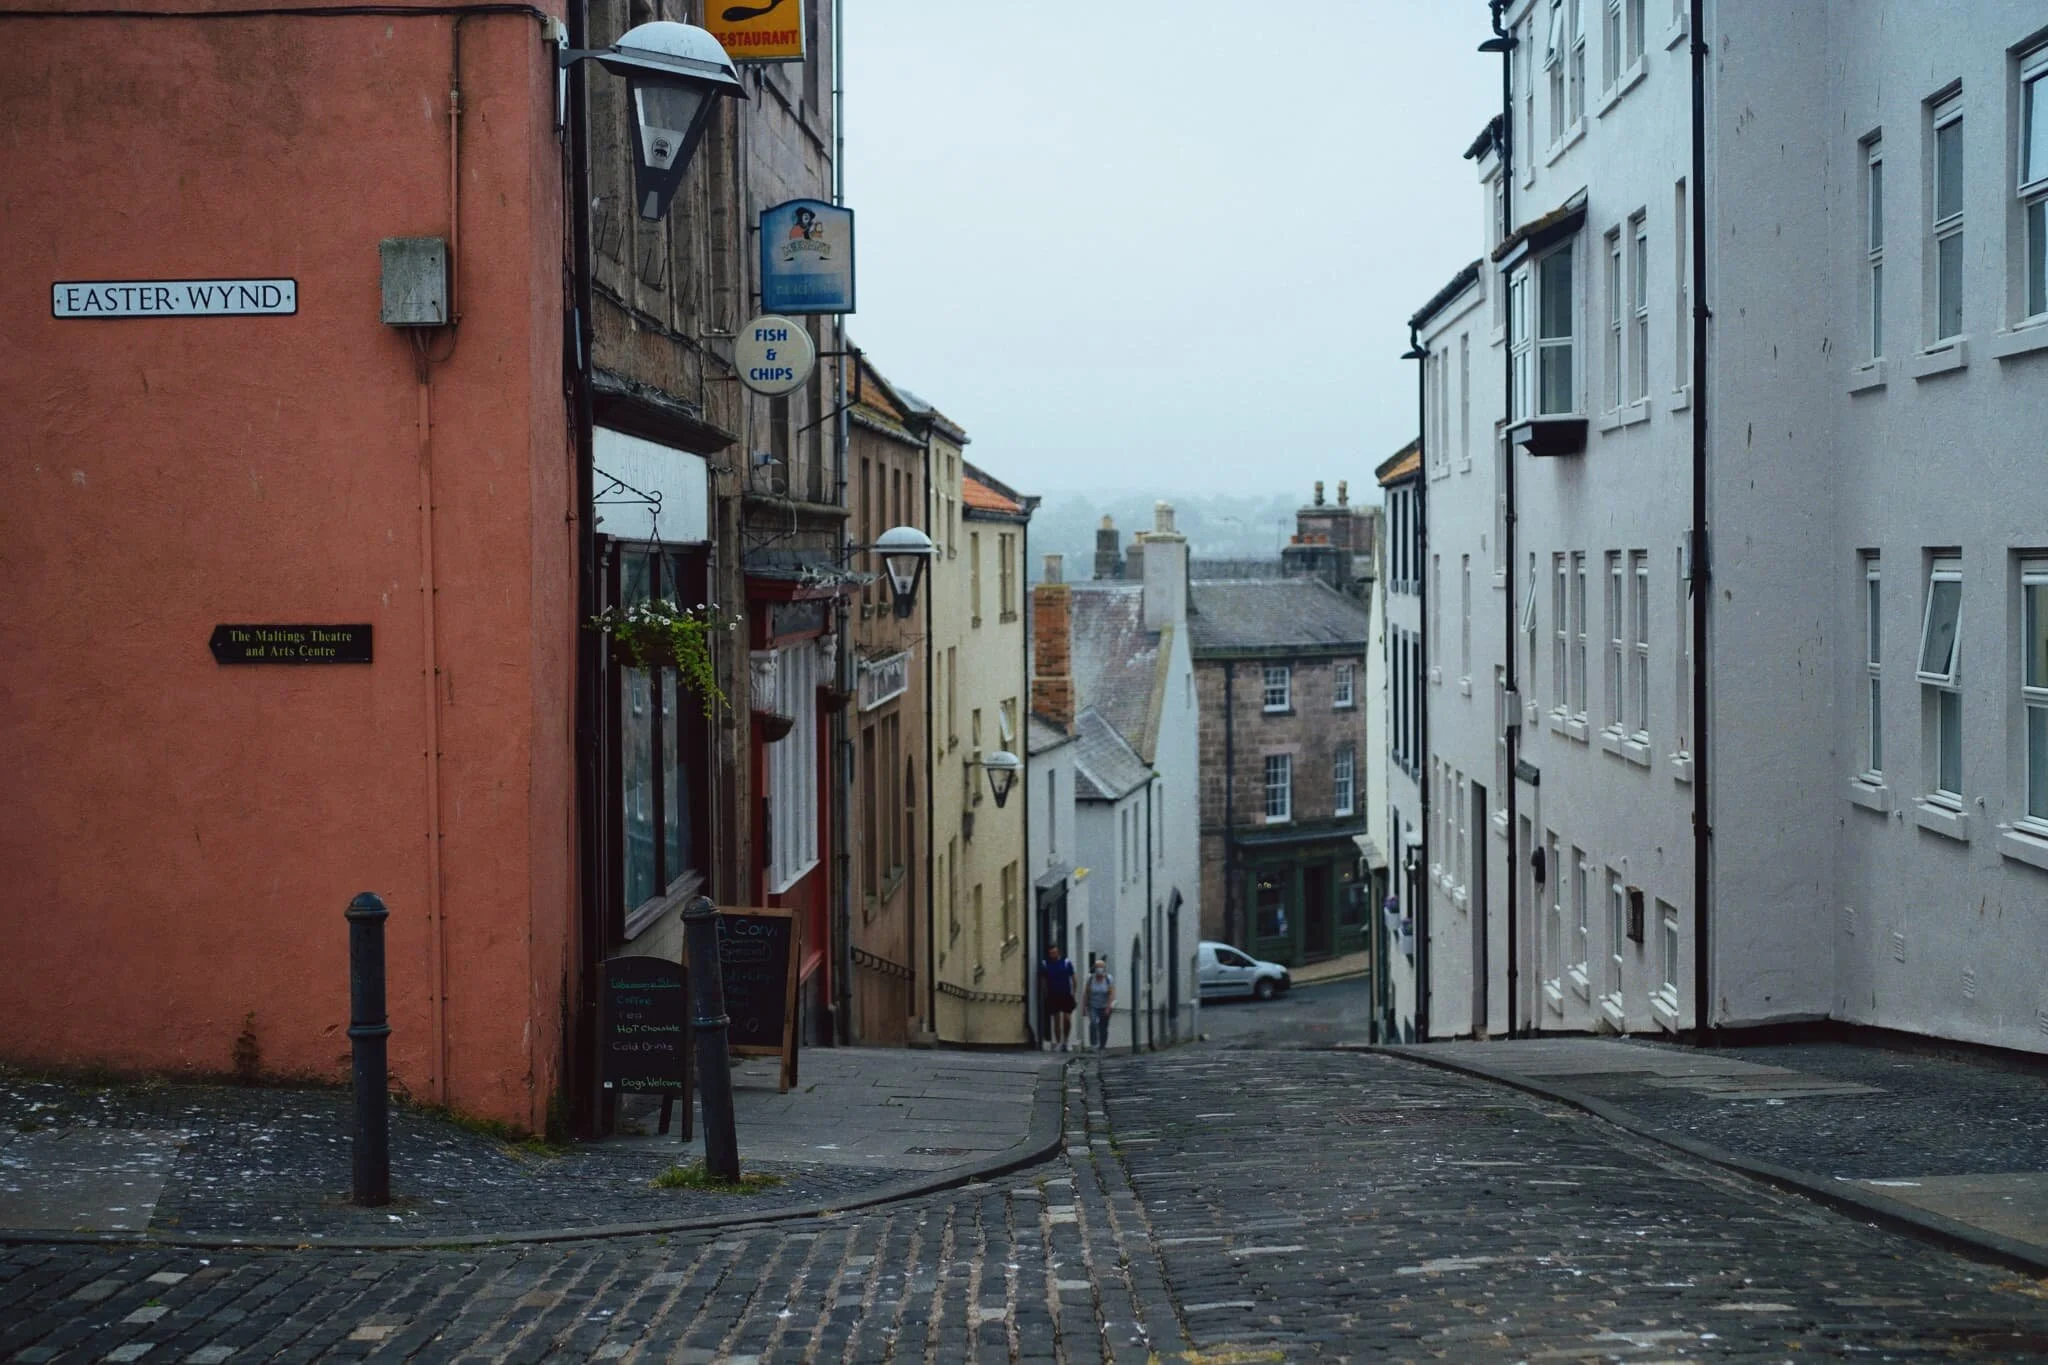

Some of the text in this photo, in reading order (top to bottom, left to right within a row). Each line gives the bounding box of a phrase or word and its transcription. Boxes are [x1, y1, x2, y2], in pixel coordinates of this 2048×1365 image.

[66, 285, 282, 312] EASTER WYND
[755, 328, 787, 342] FISH
[766, 348, 777, 361] &
[749, 367, 793, 381] CHIPS
[229, 629, 353, 644] The Maltings Theatre
[245, 645, 337, 657] and Arts Centre
[621, 1075, 683, 1090] Dogs Welcome
